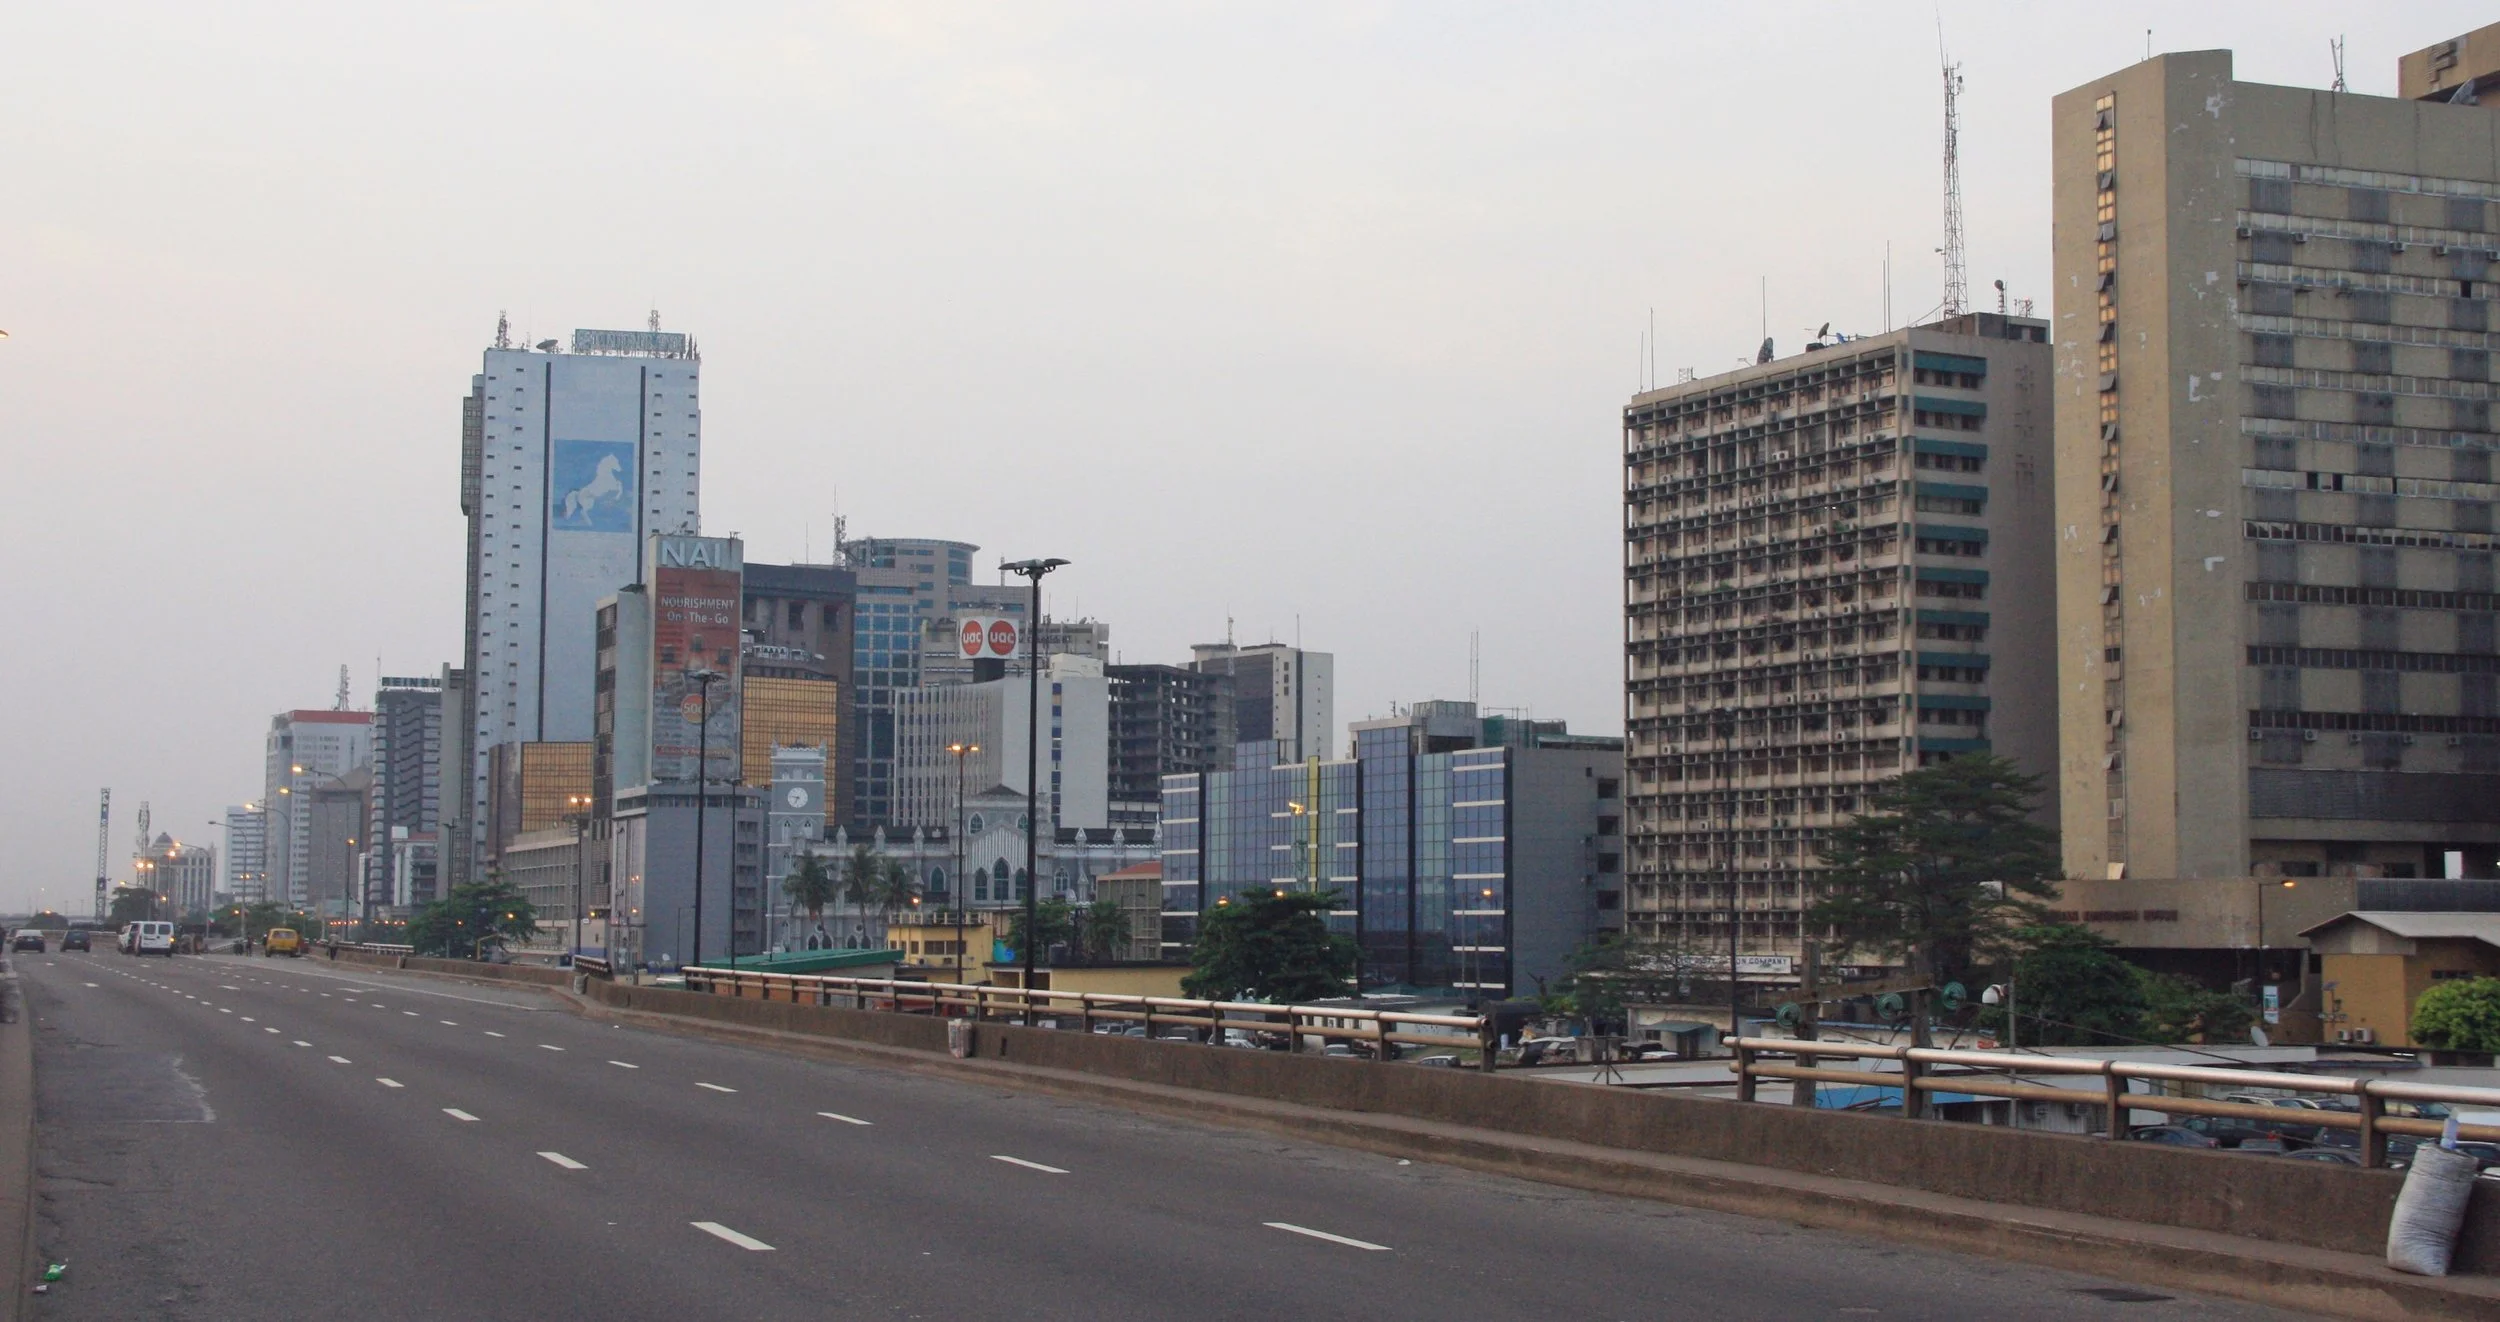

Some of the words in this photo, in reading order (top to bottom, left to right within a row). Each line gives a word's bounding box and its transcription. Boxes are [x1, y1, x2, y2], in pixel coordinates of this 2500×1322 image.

[661, 596, 735, 610] NOURISHMENT
[963, 632, 981, 643] uac
[990, 632, 1015, 643] uac
[1749, 956, 1787, 965] COMPANY
